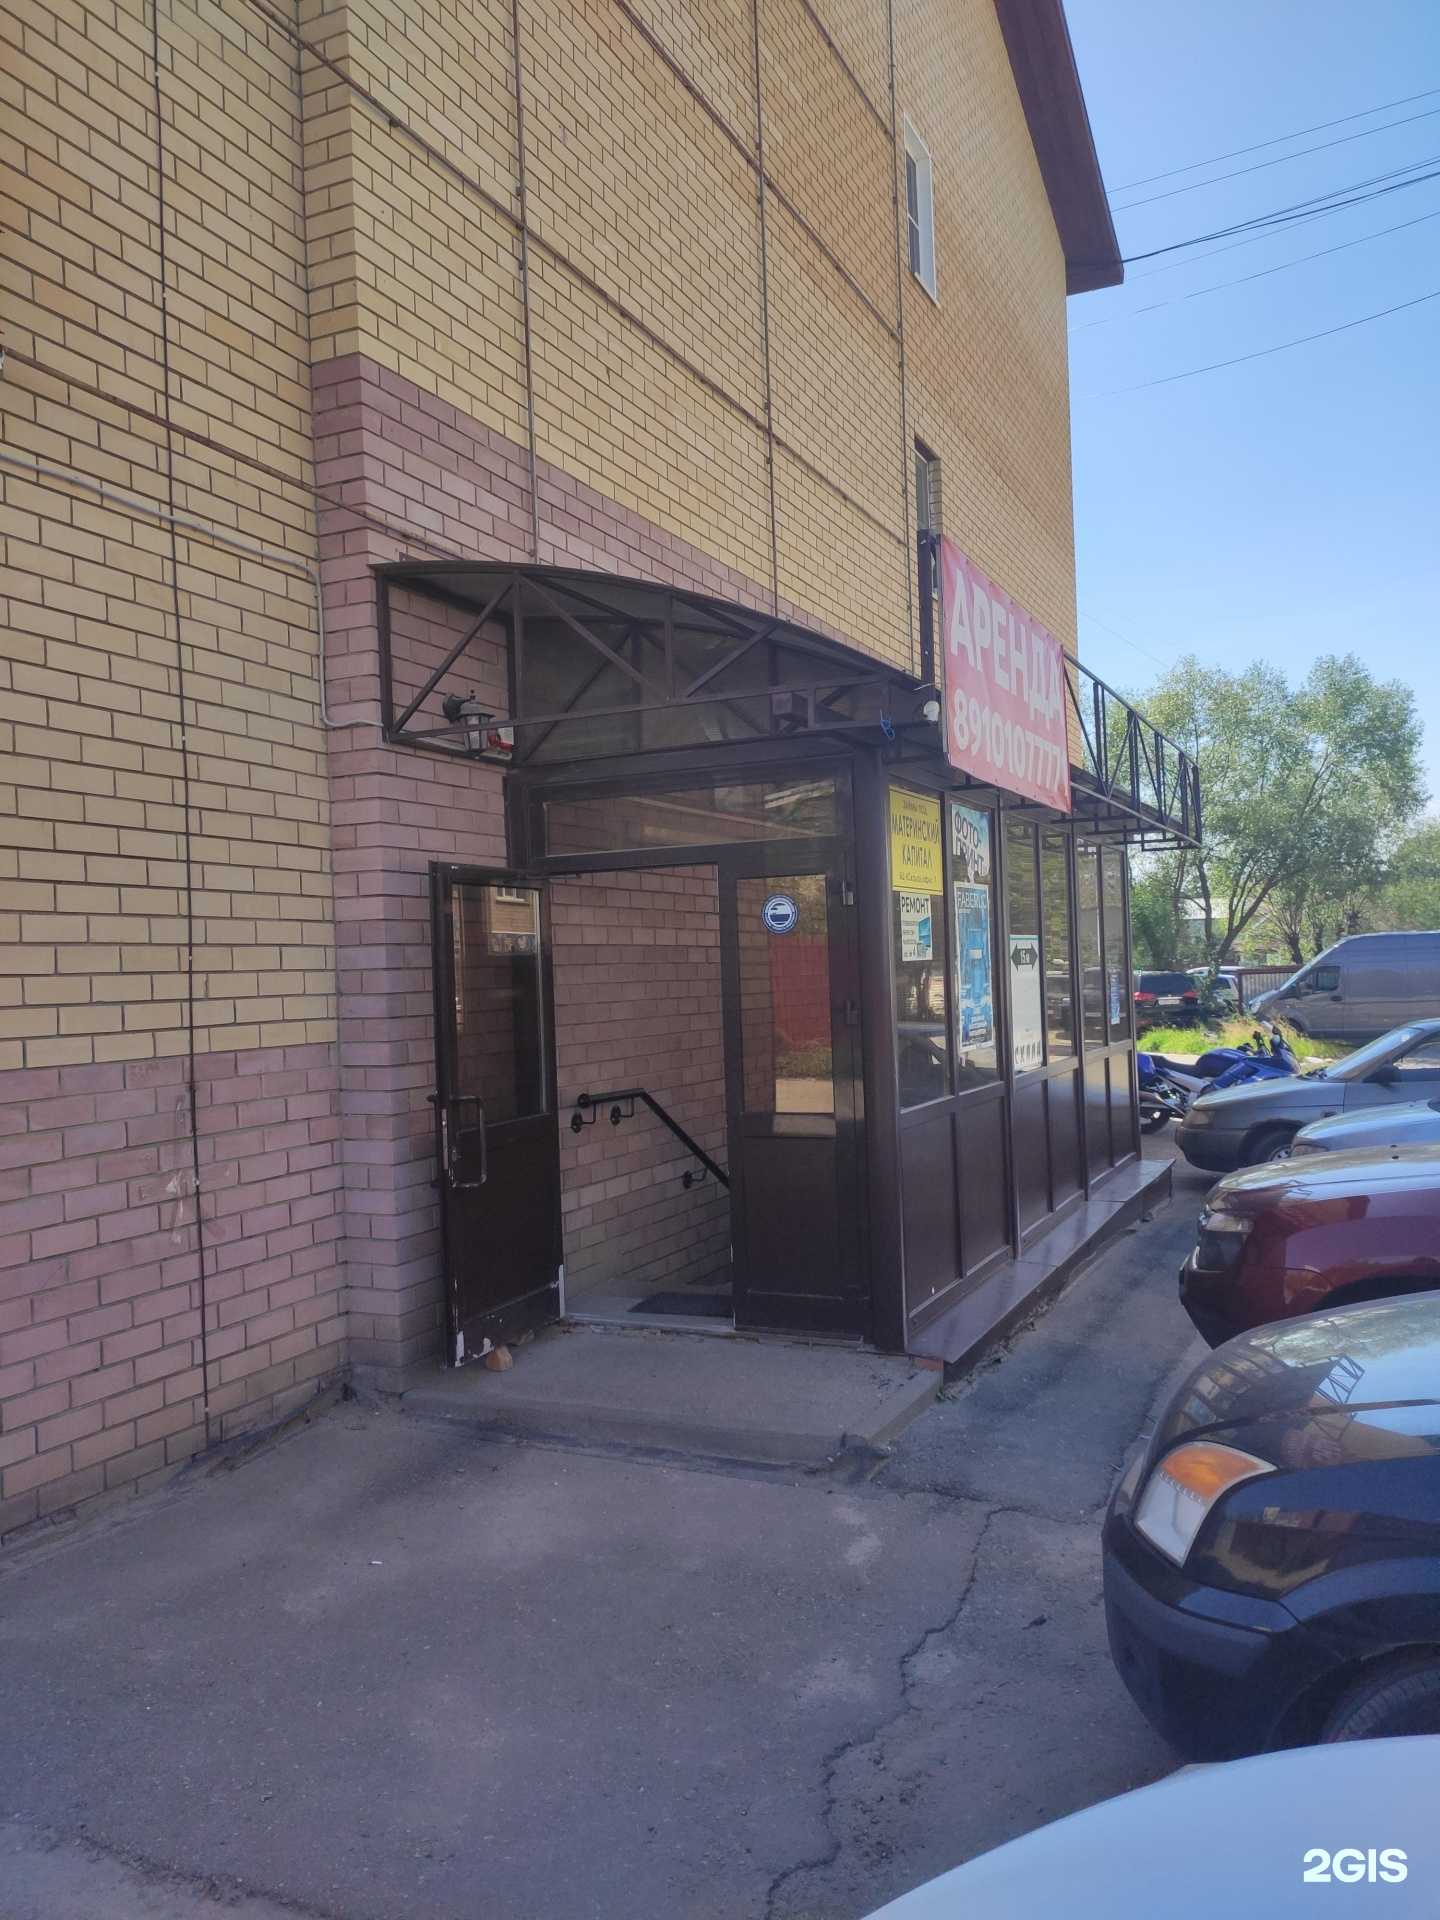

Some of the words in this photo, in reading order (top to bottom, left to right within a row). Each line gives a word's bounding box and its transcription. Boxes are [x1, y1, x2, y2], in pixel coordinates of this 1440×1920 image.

[951, 567, 1062, 728] АРЕНДА
[891, 814, 940, 845] МАТЕРИНСКИЙ
[902, 844, 933, 869] КАПИТАЛ
[901, 896, 929, 914] РЕМОНТ
